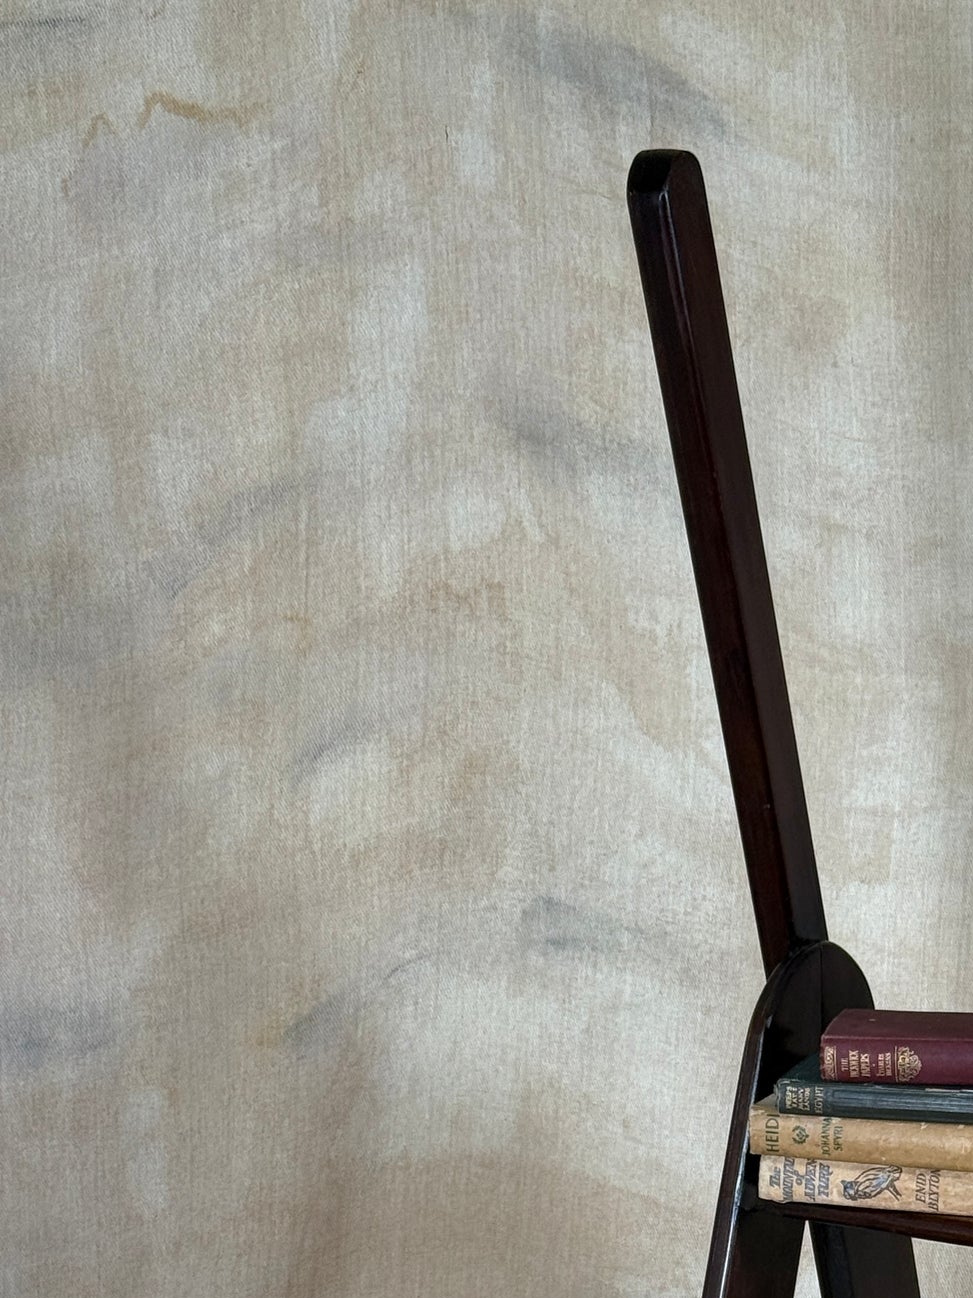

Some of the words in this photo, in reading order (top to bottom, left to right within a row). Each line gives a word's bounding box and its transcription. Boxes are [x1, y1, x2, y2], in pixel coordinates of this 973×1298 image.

[814, 1086, 824, 1114] EGYPT
[765, 1113, 780, 1153] HEIDI
[820, 1116, 832, 1157] JOHANNA
[833, 1126, 843, 1152] SPYRI
[915, 1173, 926, 1204] ENID
[927, 1169, 942, 1212] BLYTON
